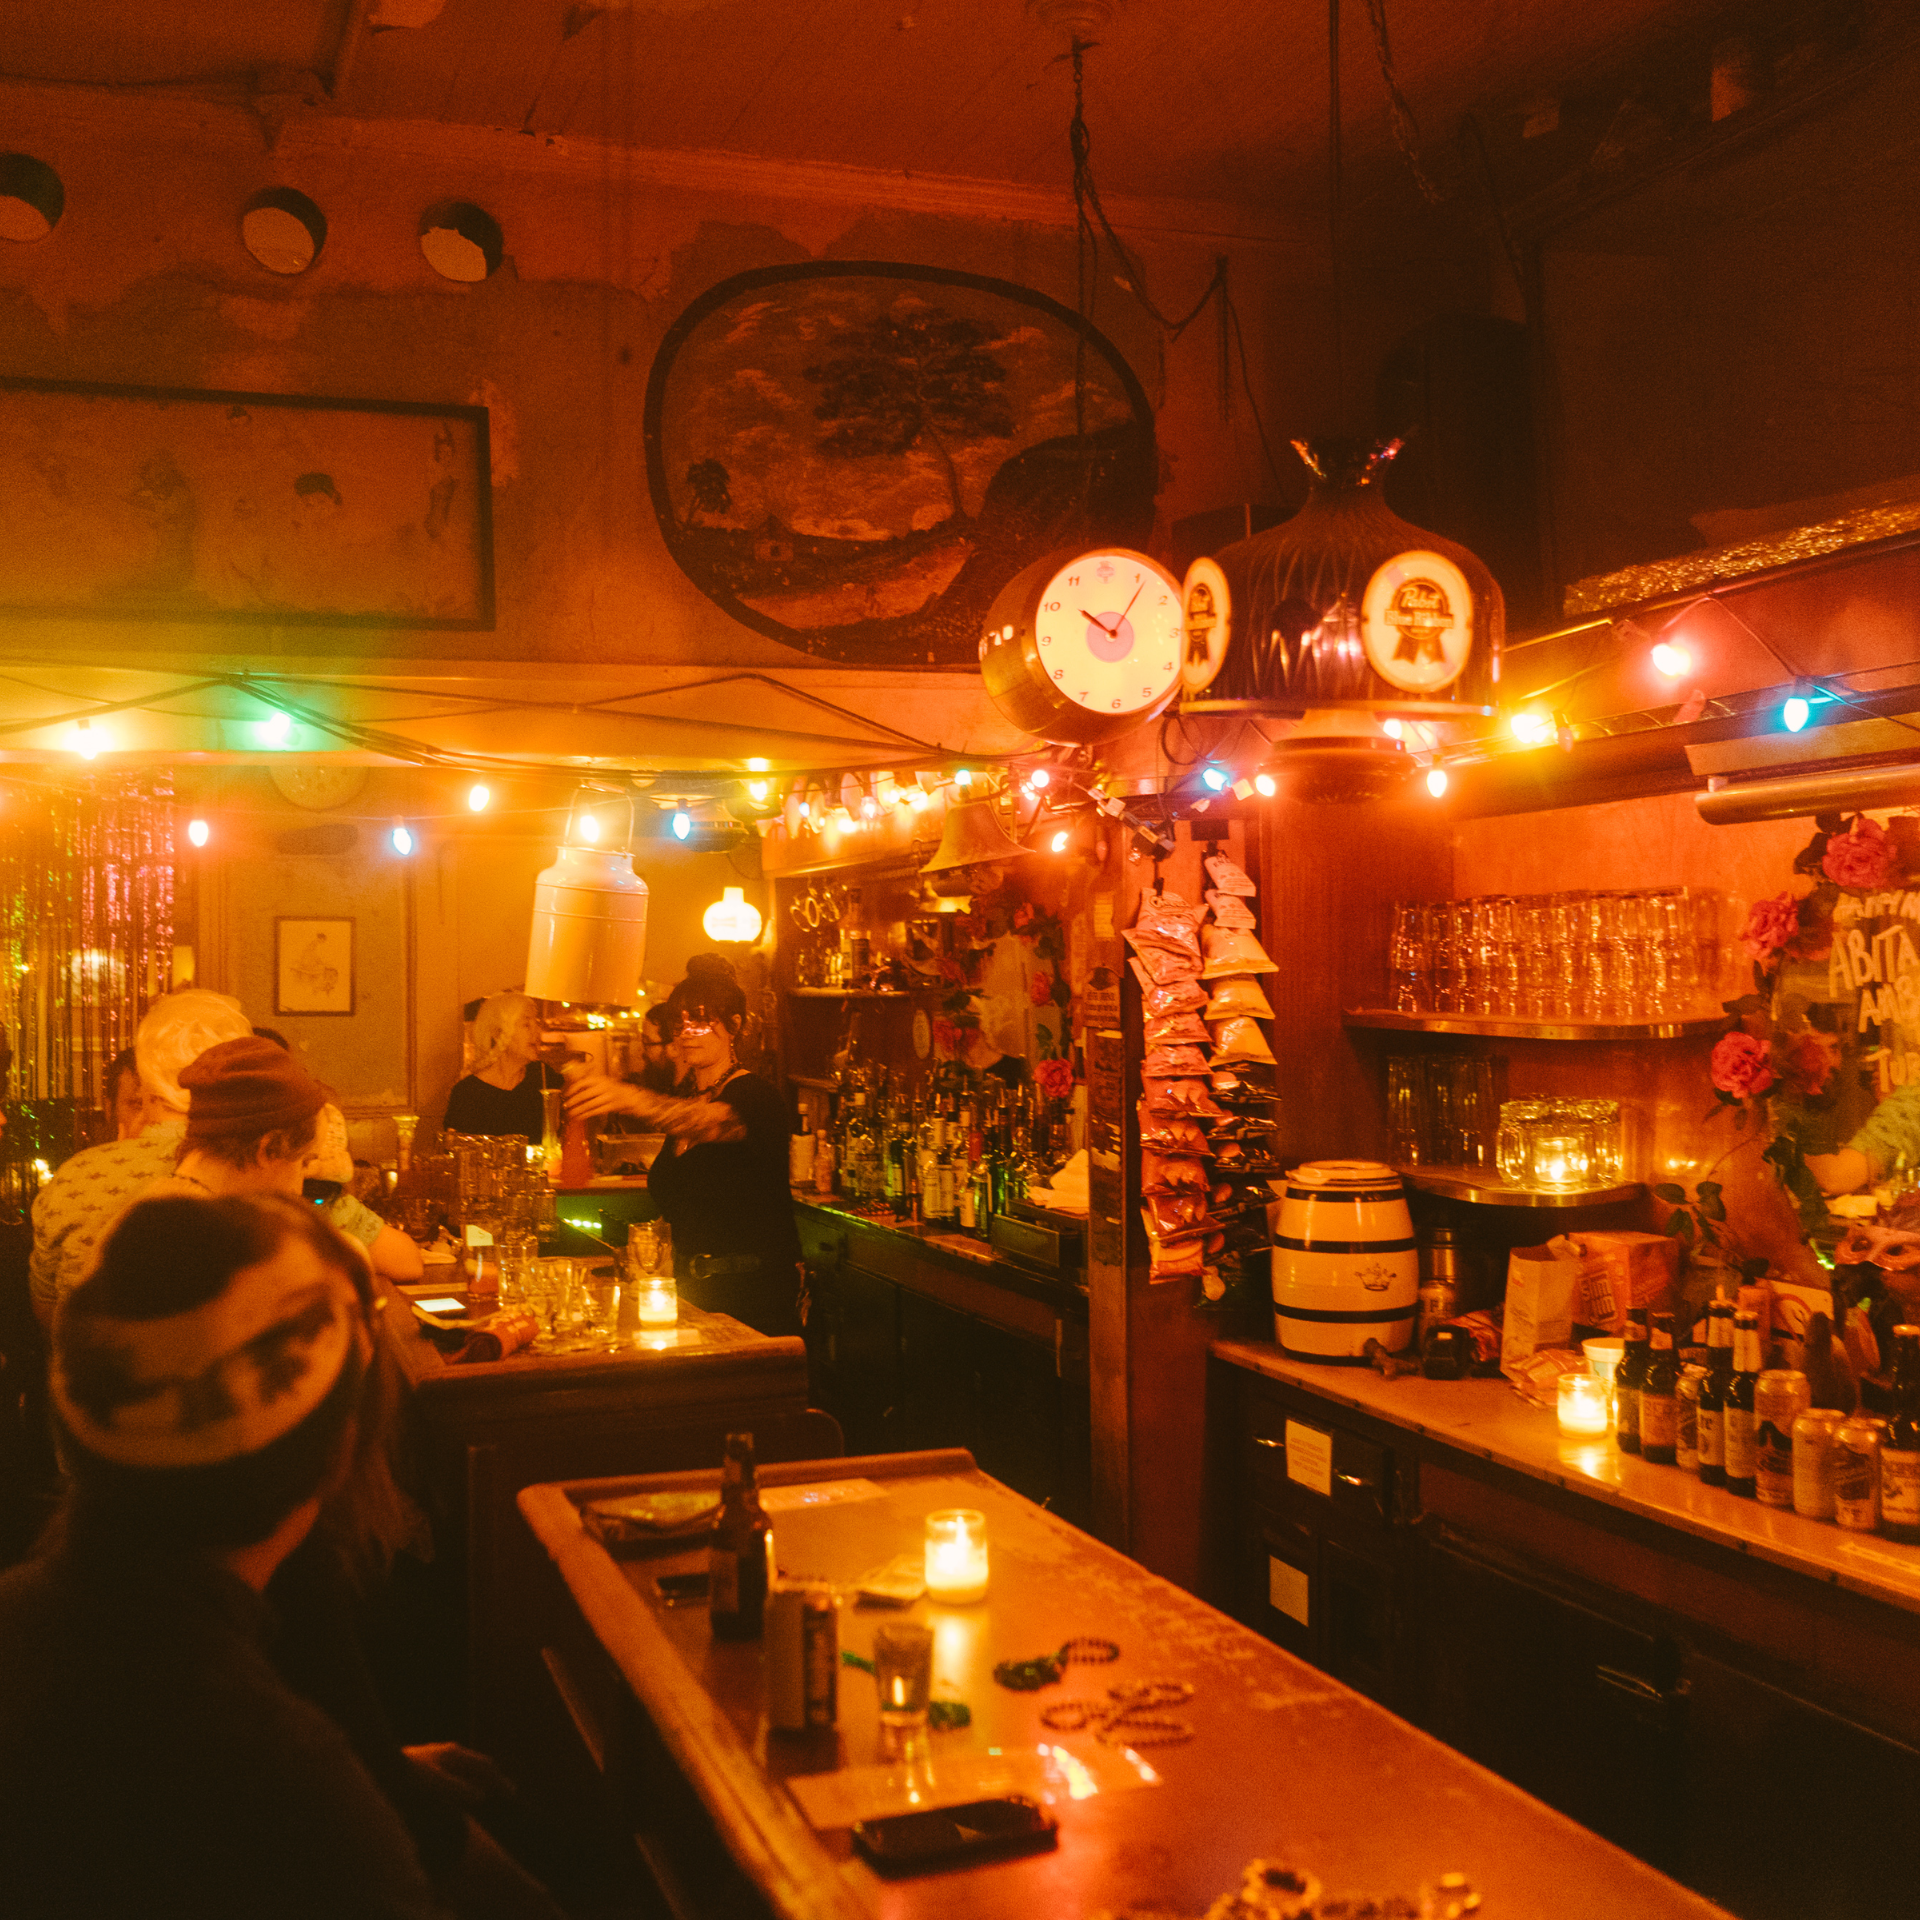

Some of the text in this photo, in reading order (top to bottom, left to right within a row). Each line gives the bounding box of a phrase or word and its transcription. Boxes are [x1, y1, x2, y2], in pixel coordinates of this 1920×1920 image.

[1067, 575, 1081, 587] 11
[1134, 573, 1141, 584] 1
[1158, 595, 1169, 606] 2
[1401, 587, 1441, 609] Pabst
[1043, 601, 1062, 612] 10
[1169, 627, 1180, 639] 3
[1041, 636, 1052, 647] 9
[1163, 661, 1174, 672] 4
[1053, 669, 1064, 680] 8
[1079, 691, 1089, 703] 7
[1142, 687, 1152, 698] 5
[1111, 698, 1122, 709] 6
[1829, 924, 1920, 998] ABITA
